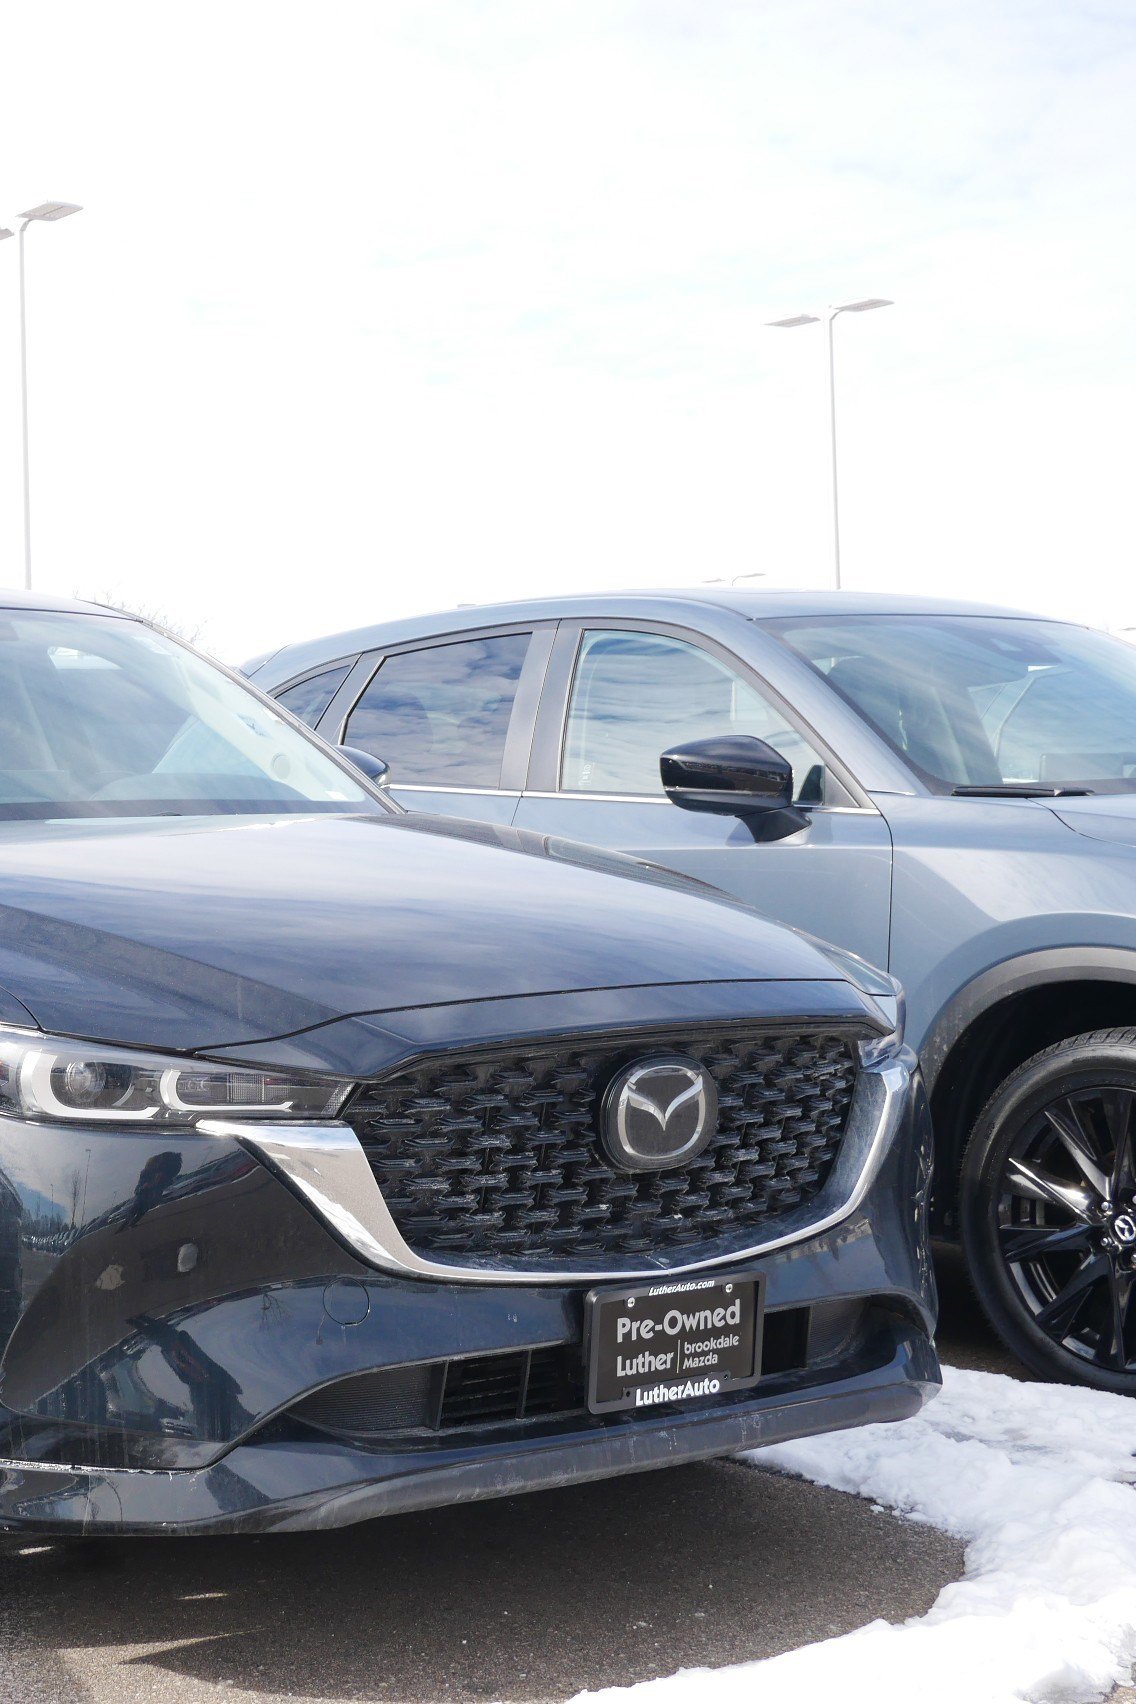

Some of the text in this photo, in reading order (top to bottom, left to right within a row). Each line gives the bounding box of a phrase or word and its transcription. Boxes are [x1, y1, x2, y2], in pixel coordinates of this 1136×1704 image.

[648, 1280, 715, 1296] LutherAuto.com
[617, 1299, 741, 1343] Pre-Owned
[684, 1334, 740, 1354] brookdale
[616, 1350, 674, 1377] Luther
[682, 1352, 718, 1369] Mazda
[635, 1377, 720, 1406] LutherAuto
